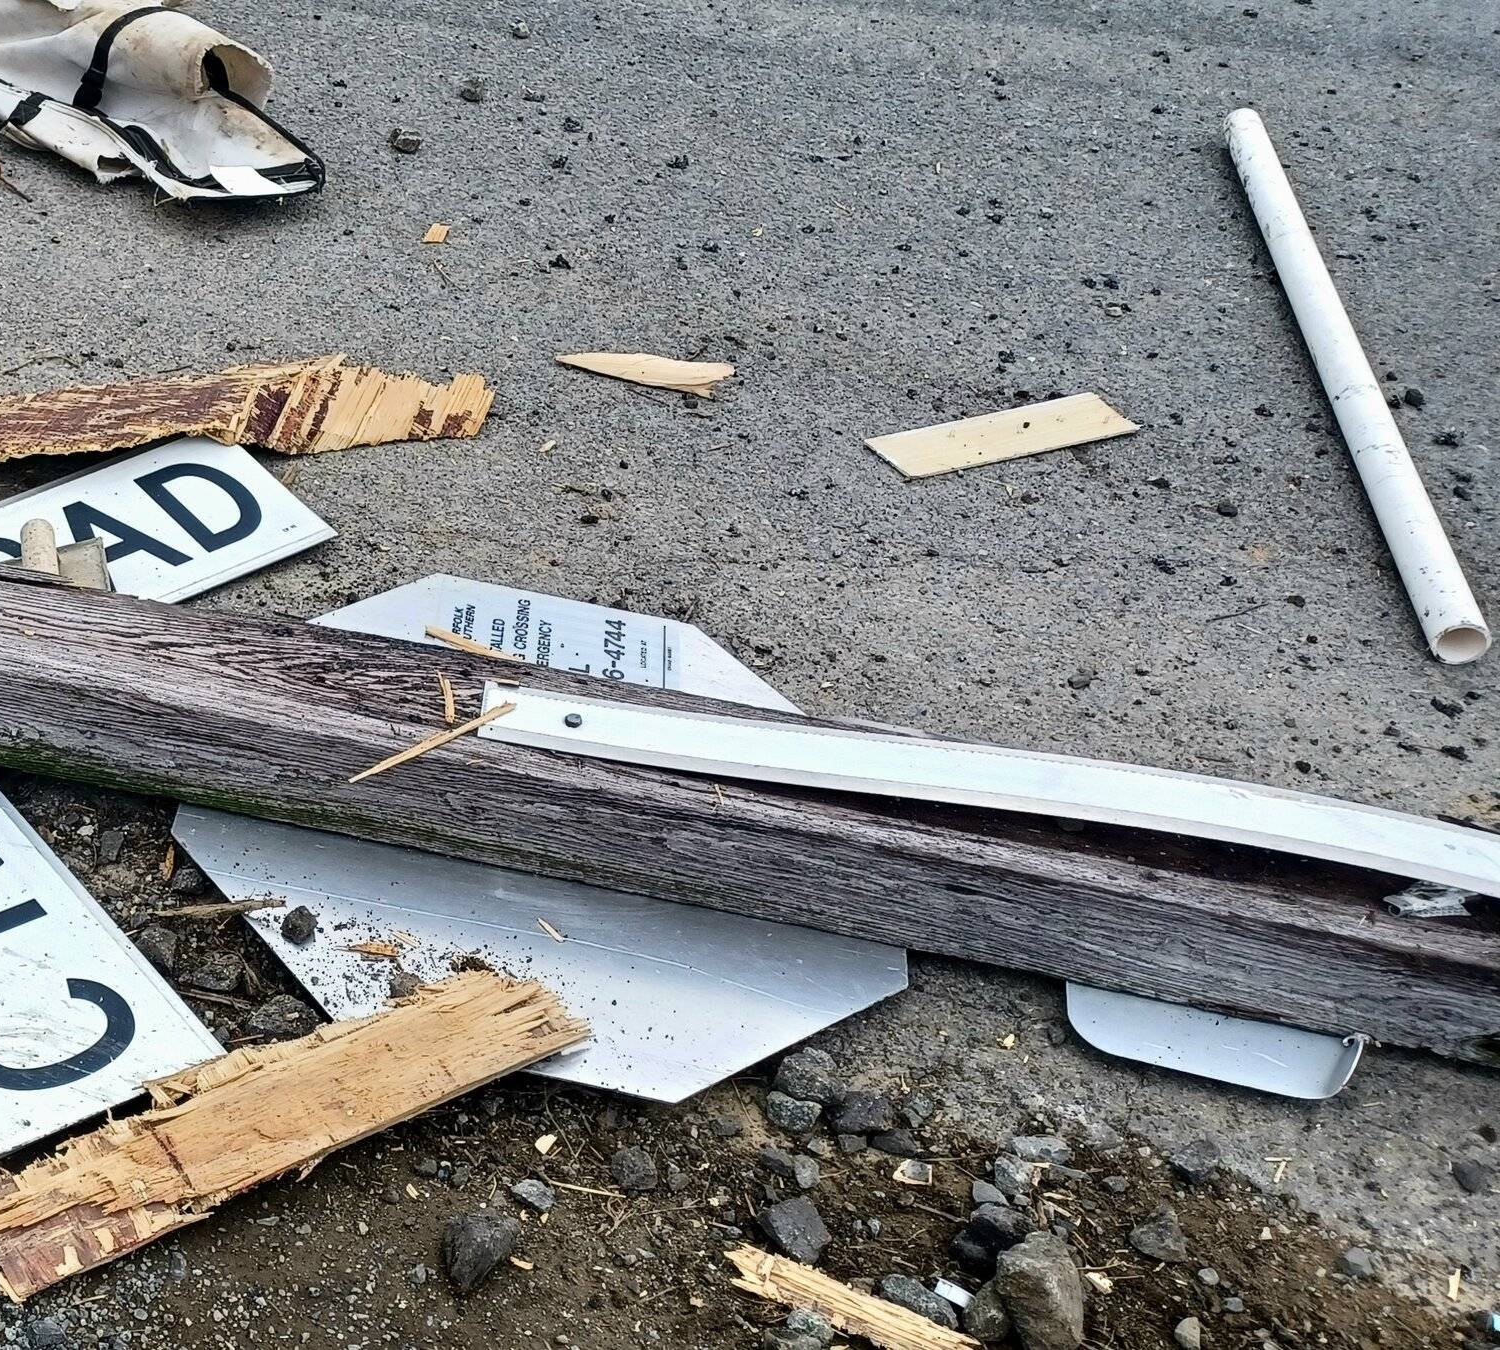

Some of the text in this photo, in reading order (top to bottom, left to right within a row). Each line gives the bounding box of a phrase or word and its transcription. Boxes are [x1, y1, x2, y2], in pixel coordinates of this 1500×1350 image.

[452, 606, 464, 635] RFOLK
[463, 603, 476, 641] UTHERN
[489, 618, 505, 652] ALLED
[513, 598, 531, 650] CROSSING
[536, 619, 553, 668] ERGENCY
